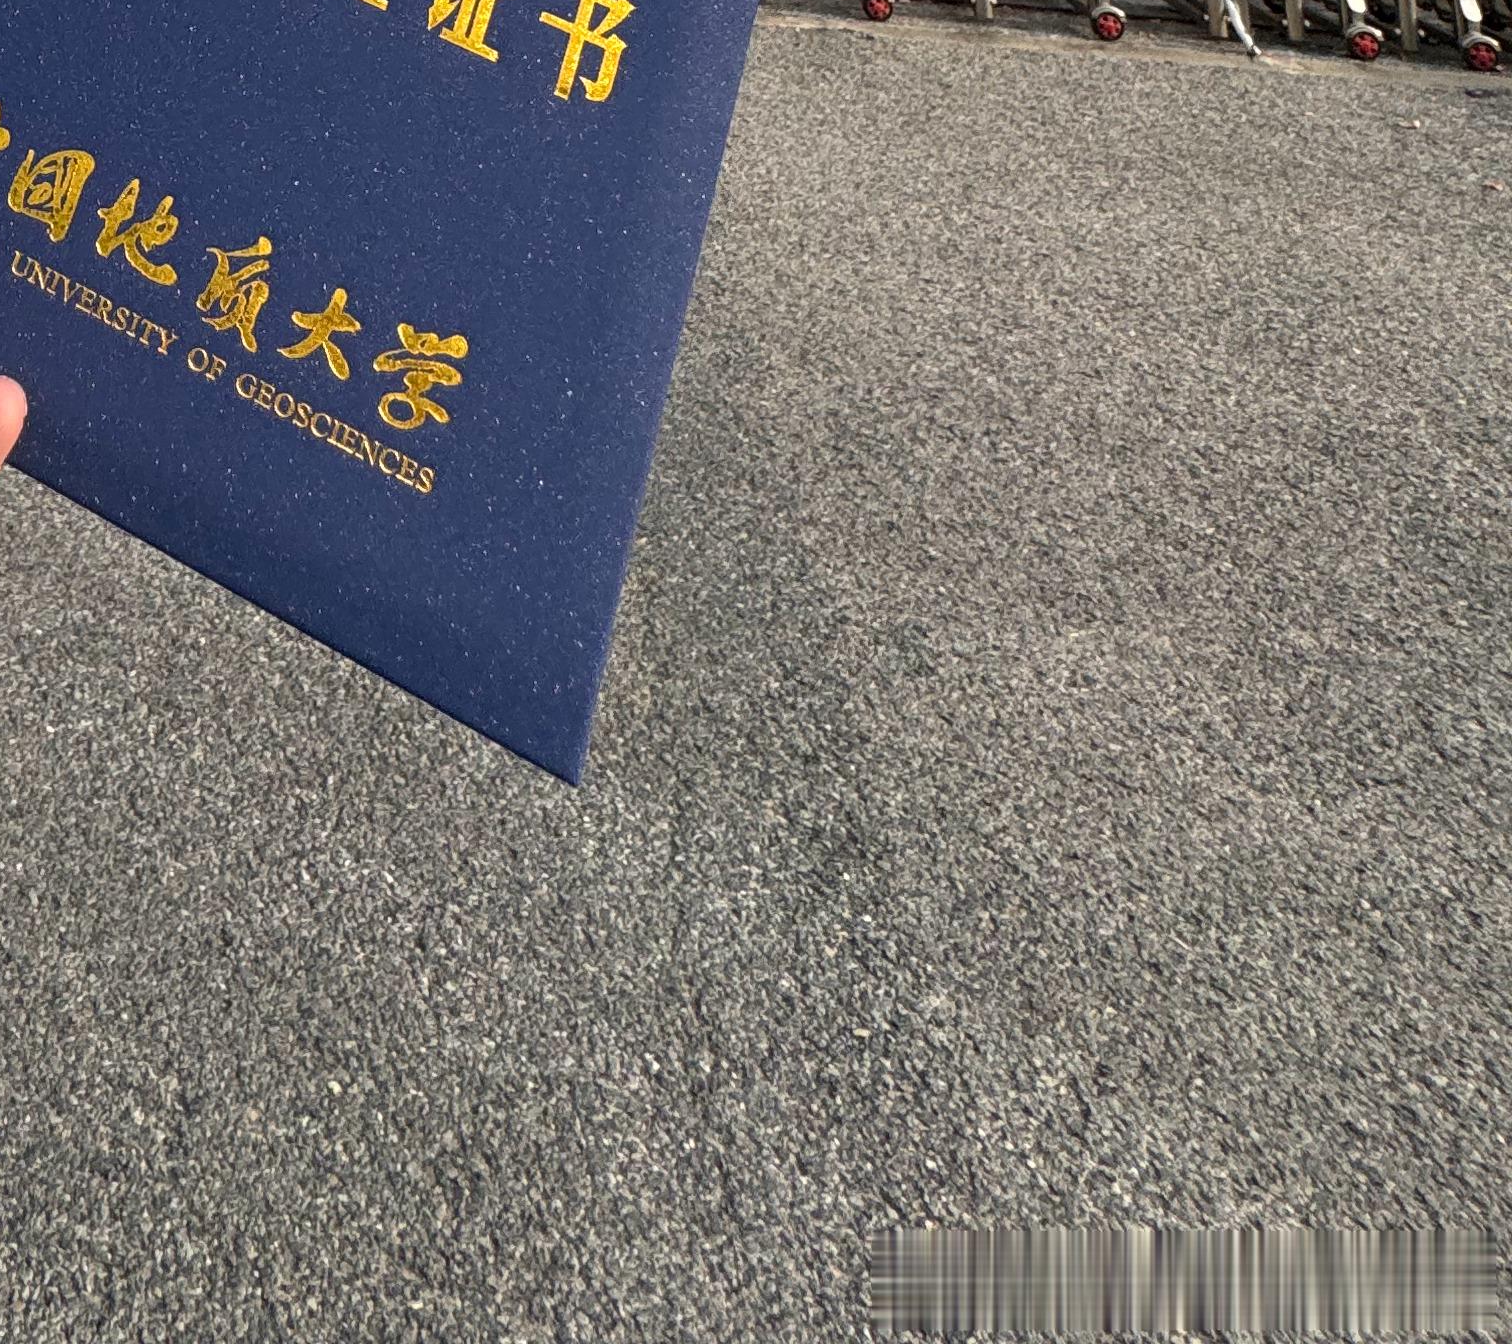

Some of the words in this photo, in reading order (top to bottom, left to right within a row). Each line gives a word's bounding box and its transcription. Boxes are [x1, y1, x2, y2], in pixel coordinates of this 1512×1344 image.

[11, 250, 179, 356] UNIVERSITY
[187, 346, 227, 381] OF
[235, 373, 436, 494] GEOSCIENCES
